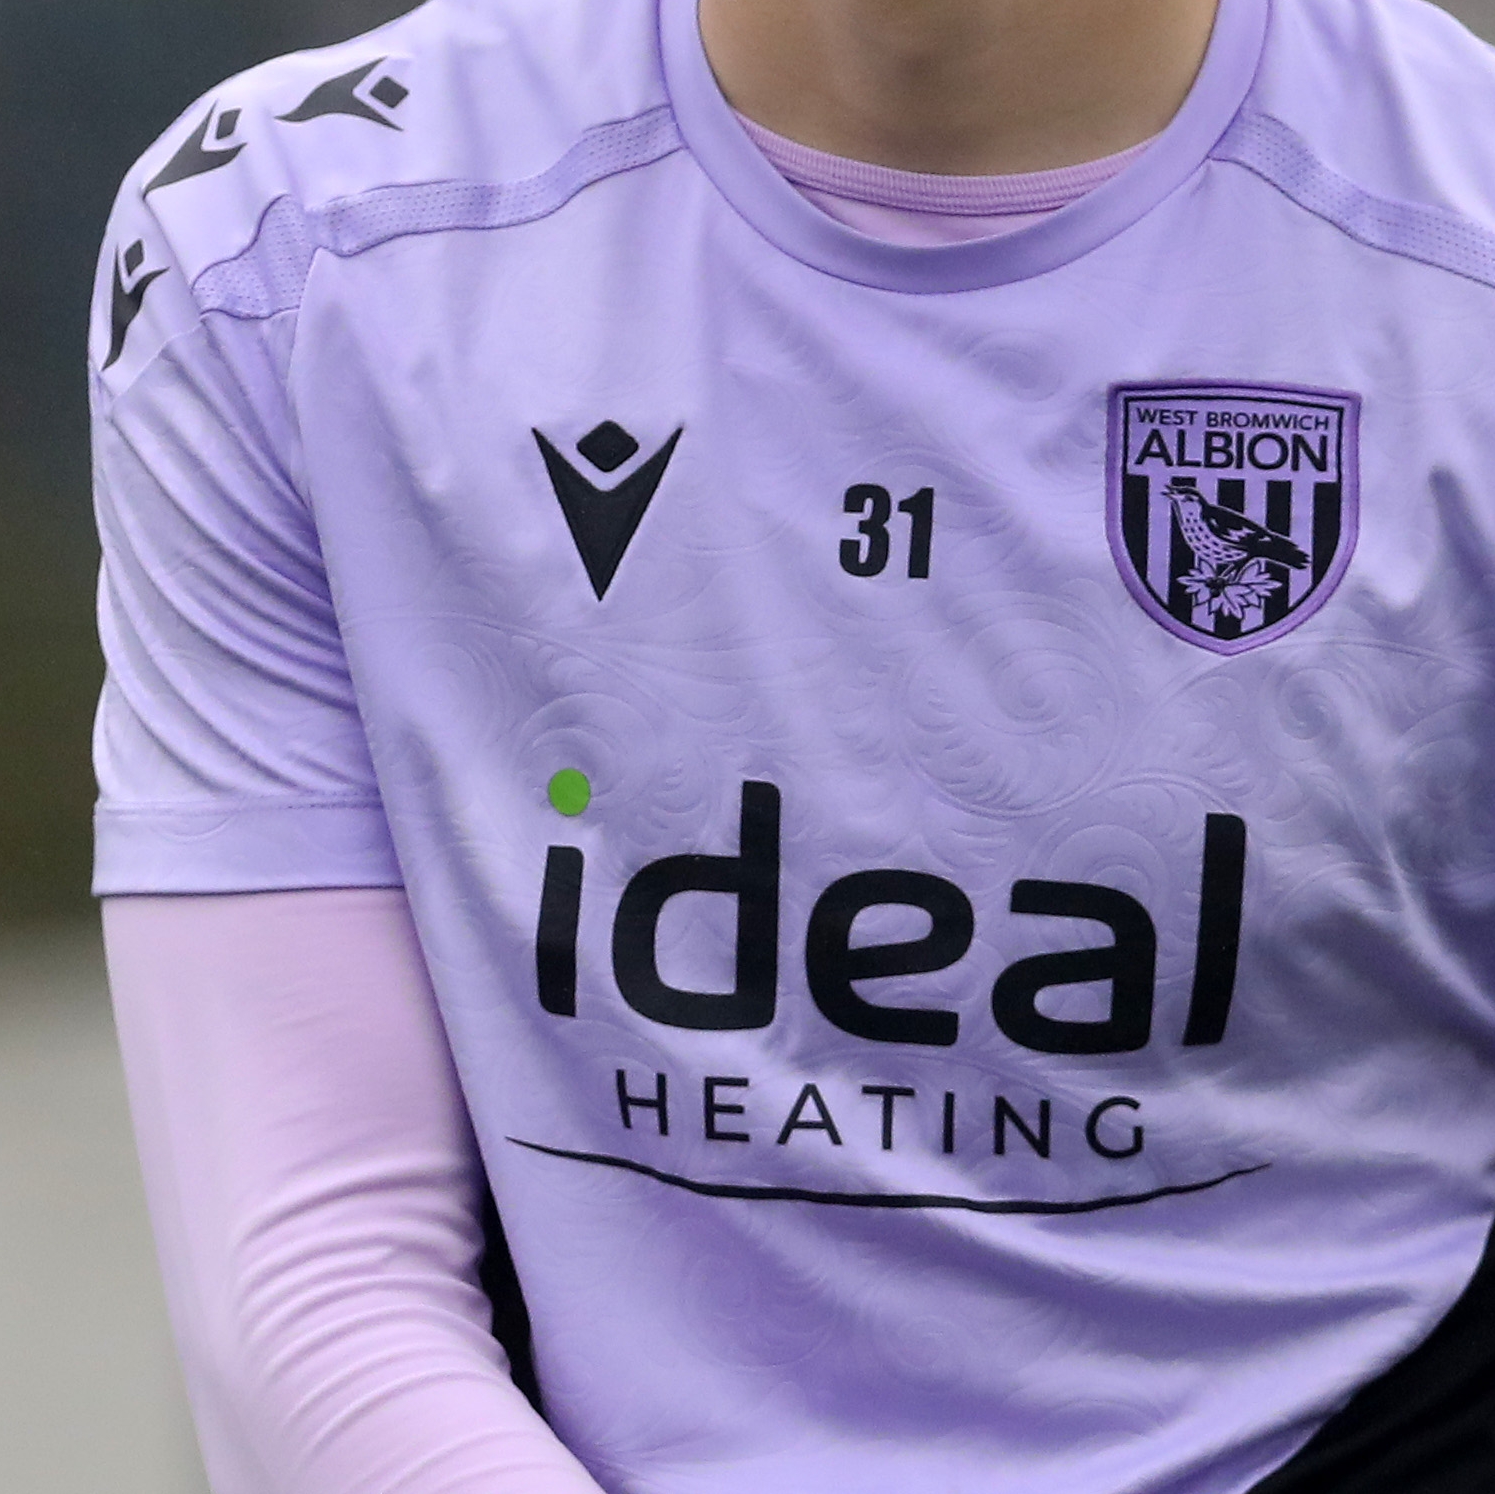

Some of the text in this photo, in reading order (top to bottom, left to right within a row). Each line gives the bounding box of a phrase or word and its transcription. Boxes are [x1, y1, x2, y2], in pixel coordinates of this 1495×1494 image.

[1134, 429, 1328, 472] ALBION
[1137, 407, 1329, 431] WEST BROMWICH
[838, 483, 934, 579] 31
[536, 768, 1247, 1055] ideal
[615, 1068, 1145, 1158] HEATING
